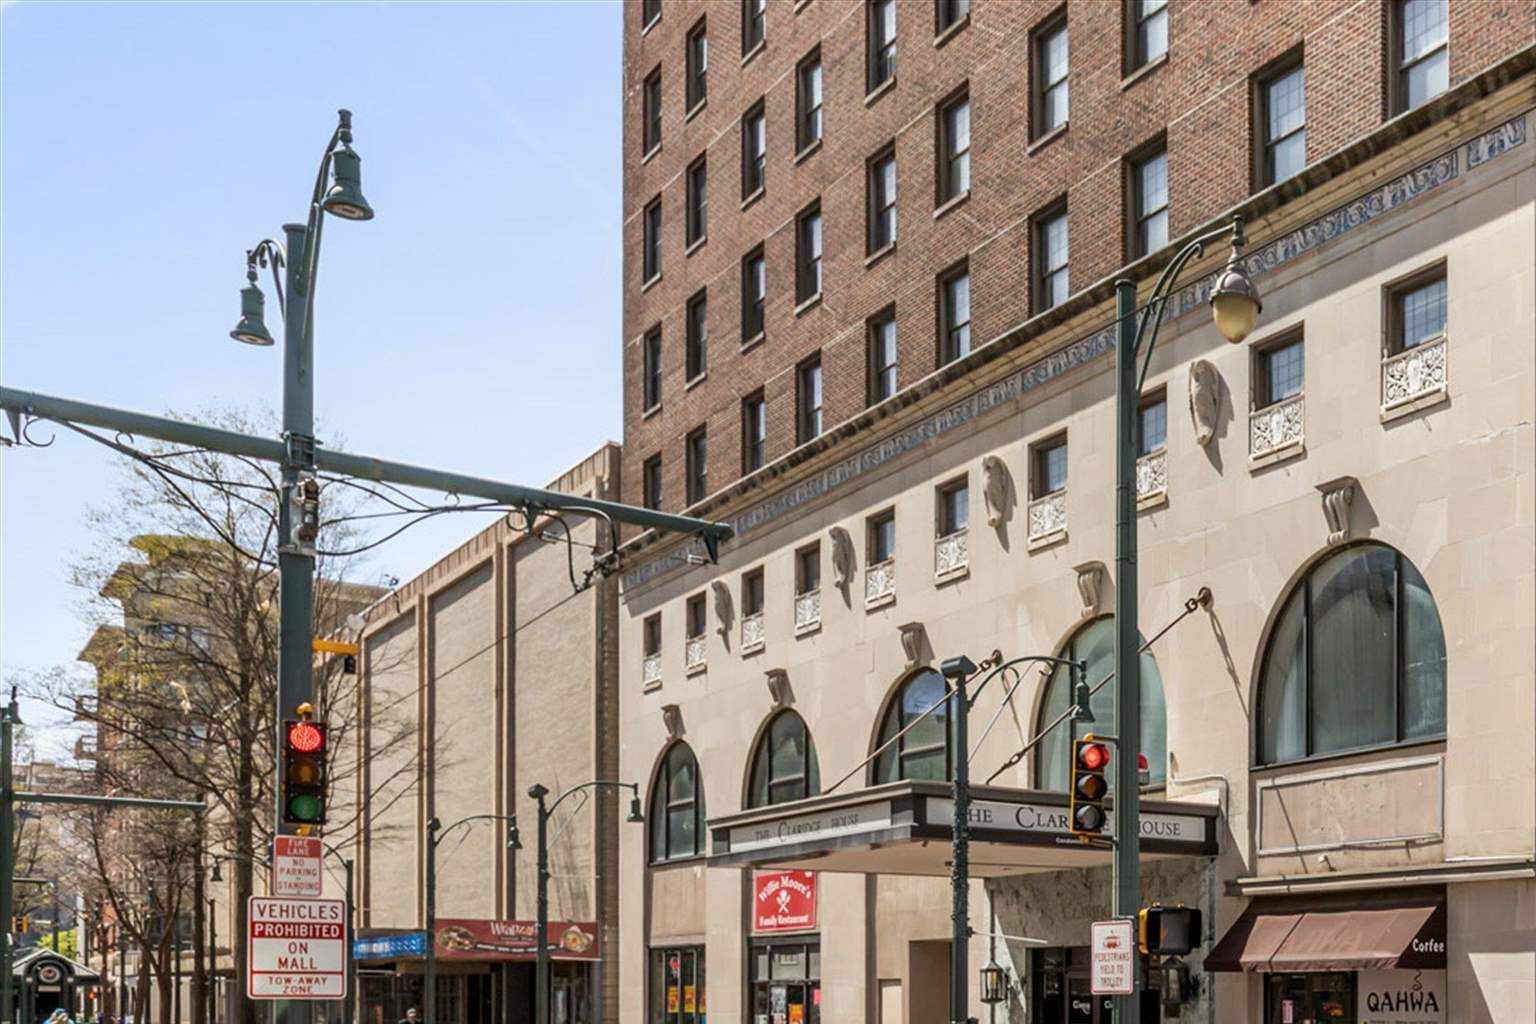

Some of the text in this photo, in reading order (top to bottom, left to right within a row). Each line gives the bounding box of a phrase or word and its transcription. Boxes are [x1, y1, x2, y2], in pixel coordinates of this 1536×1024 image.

[968, 807, 993, 823] HE
[755, 829, 770, 843] THE
[831, 813, 859, 830] HOUSE
[288, 839, 309, 848] FIRE
[287, 847, 310, 856] LANE
[292, 858, 305, 866] NO
[279, 867, 317, 877] PARKING
[278, 881, 321, 891] STANDING
[758, 875, 811, 903] Willie Moore's
[257, 903, 339, 920] VEHICLES
[759, 914, 809, 927] Family Restaurant
[254, 923, 340, 938] PROHIBITED
[288, 942, 308, 954] ON
[1095, 952, 1129, 962] PEDESTRIANS
[278, 957, 318, 970] MALL
[1101, 964, 1124, 974] YIELD TO
[268, 976, 327, 985] TOW-AWAY
[282, 985, 313, 994] ZONE
[1367, 991, 1439, 1013] QAHWA
